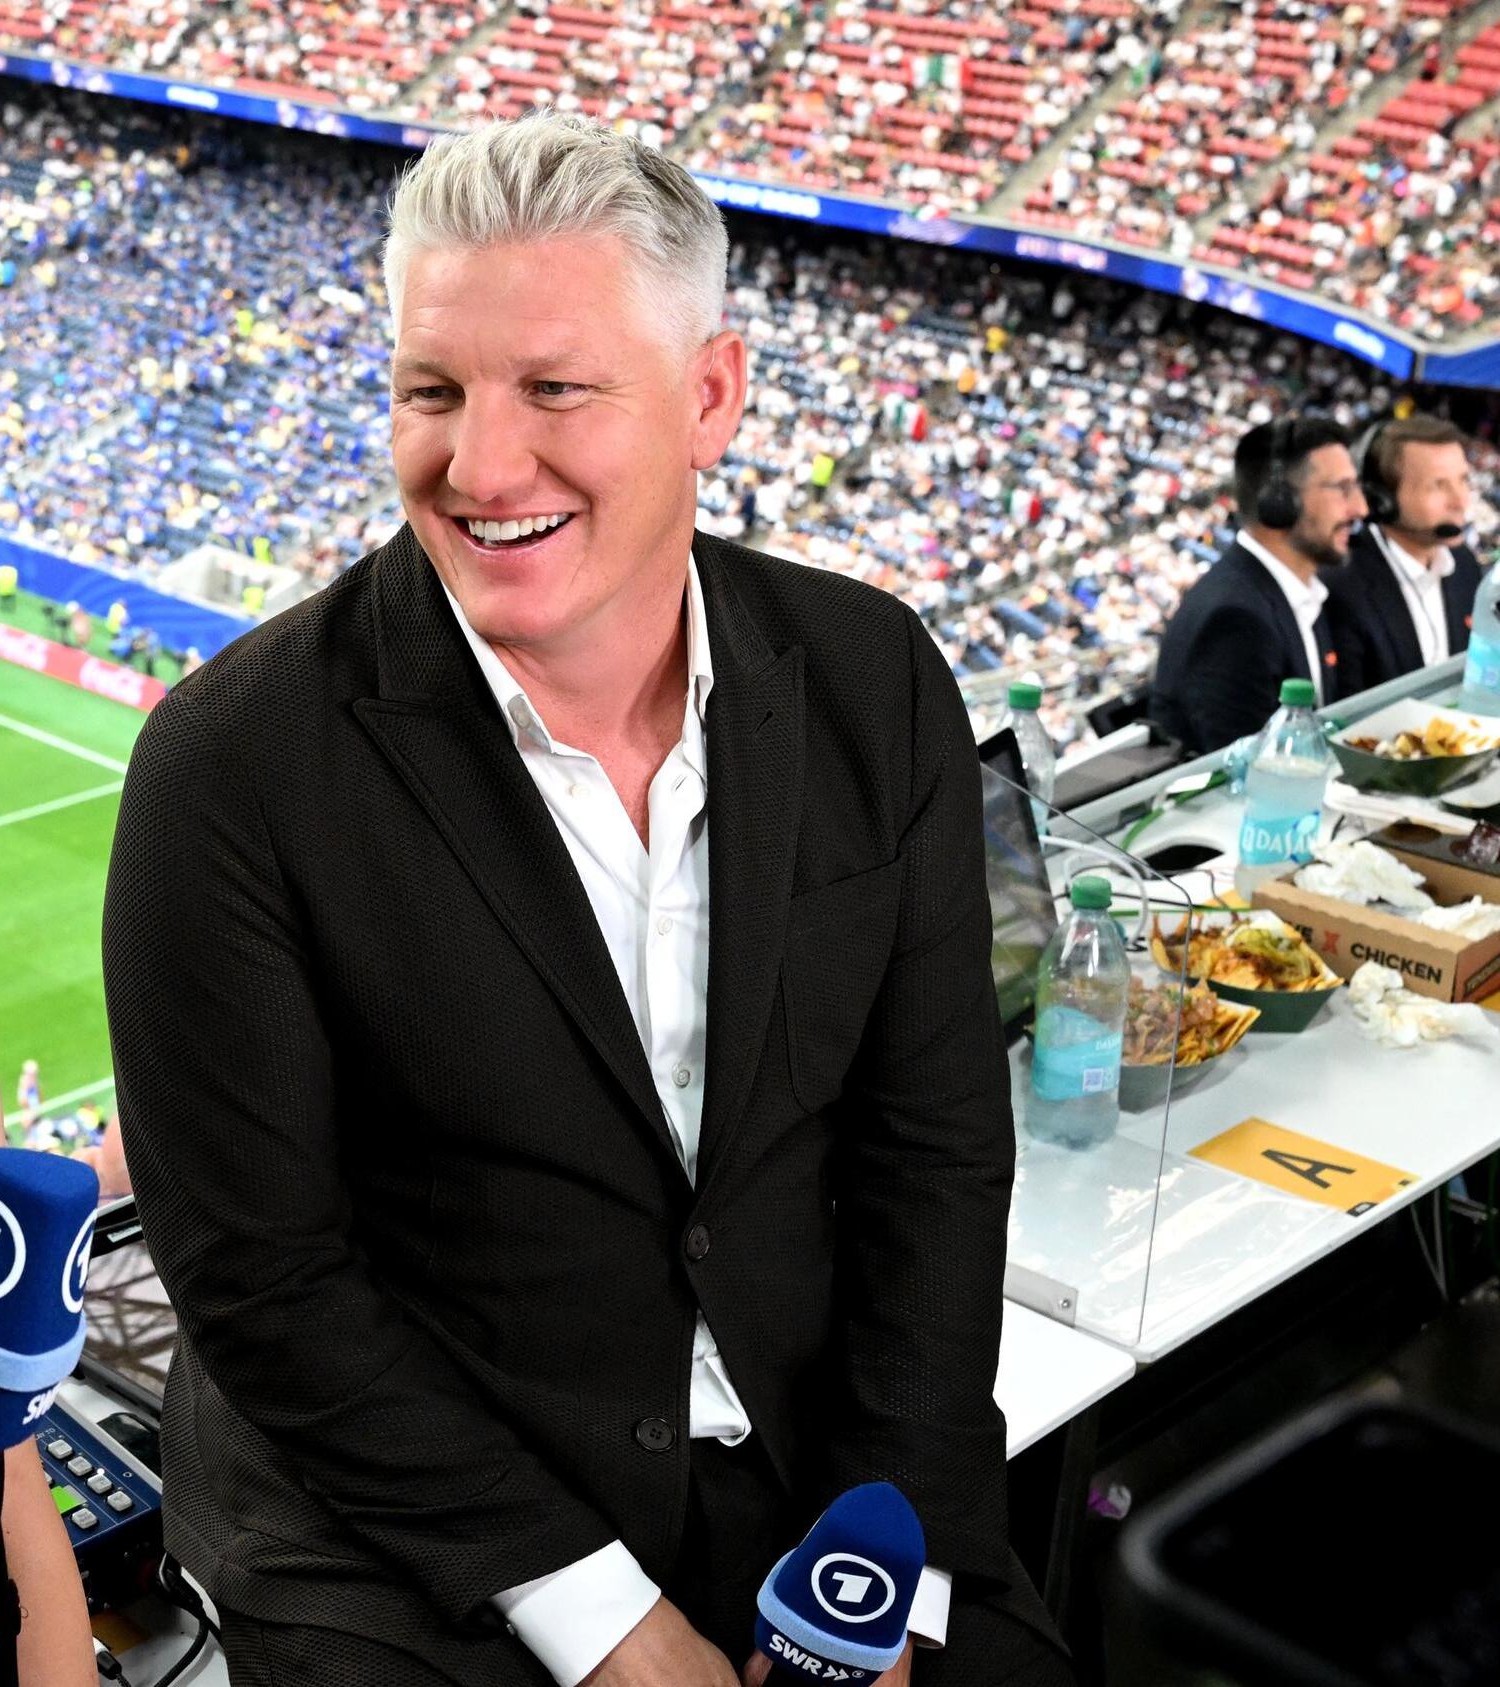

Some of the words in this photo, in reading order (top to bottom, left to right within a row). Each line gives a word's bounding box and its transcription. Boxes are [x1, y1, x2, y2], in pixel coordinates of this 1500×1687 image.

[1351, 942, 1442, 985] CHICKEN
[1261, 1149, 1356, 1190] A
[832, 1572, 872, 1603] 1
